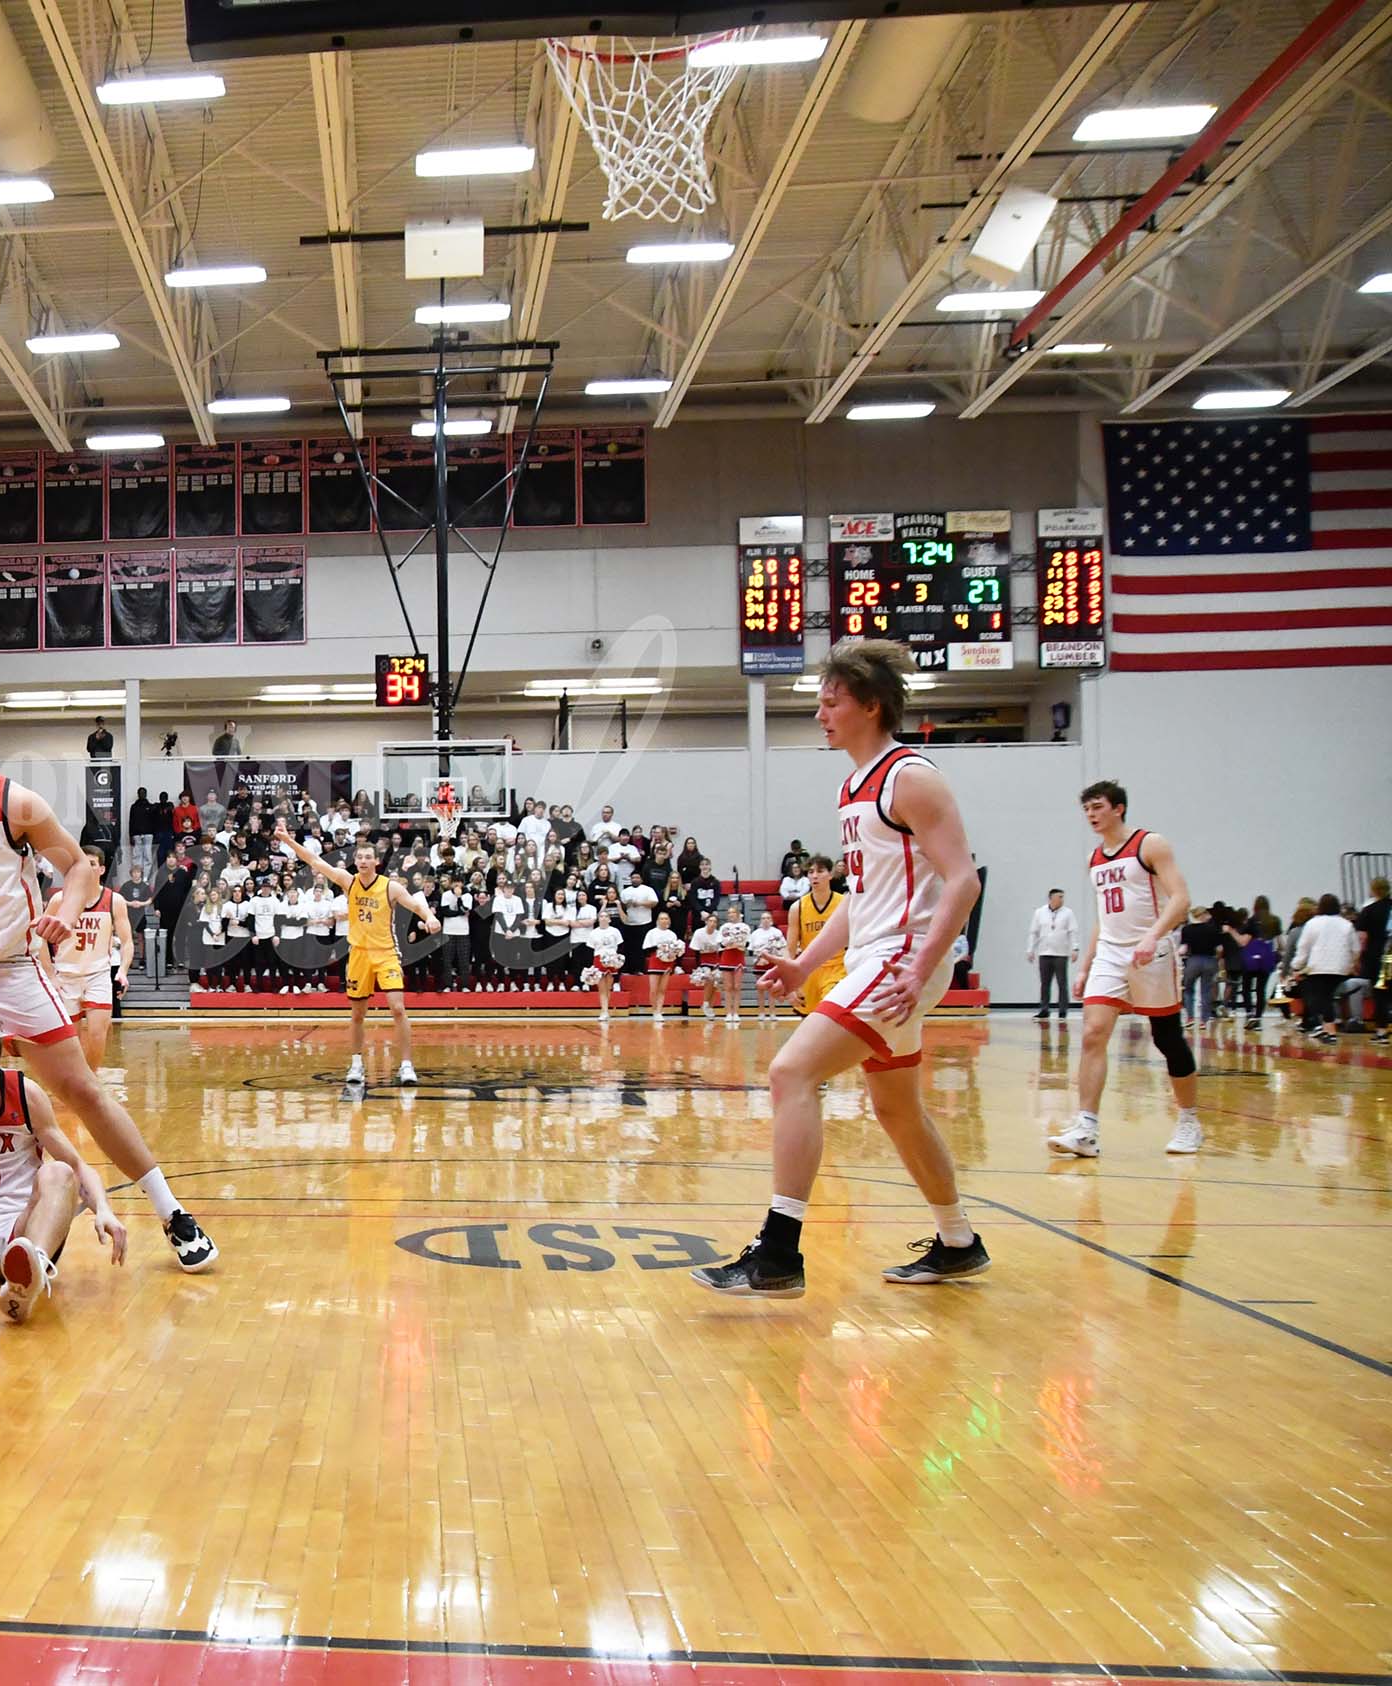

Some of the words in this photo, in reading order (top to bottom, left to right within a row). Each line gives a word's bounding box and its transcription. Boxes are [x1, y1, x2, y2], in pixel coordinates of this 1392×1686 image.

[841, 520, 877, 535] ACE
[896, 514, 944, 528] BRANDON
[901, 526, 939, 538] VALLEY
[902, 541, 953, 566] 7:24
[1051, 551, 1063, 566] 2
[753, 559, 763, 573] 5
[766, 559, 778, 573] 0
[789, 558, 800, 573] 2
[961, 566, 998, 578] GUEST
[1089, 565, 1101, 579] 3
[748, 574, 764, 588] 10
[770, 574, 778, 586] 1
[788, 573, 799, 585] 4
[844, 569, 875, 581] HOME
[906, 574, 933, 582] PERIOD
[849, 582, 880, 605] 22
[915, 583, 928, 603] 3
[968, 579, 999, 604] 27
[1047, 581, 1064, 595] 12
[1066, 580, 1078, 595] 2
[745, 589, 764, 603] 24
[771, 589, 778, 601] 1
[784, 589, 800, 601] 11
[1043, 595, 1064, 610] 23
[1066, 595, 1078, 609] 2
[1088, 594, 1101, 609] 2
[746, 603, 764, 617] 34
[789, 602, 800, 615] 3
[840, 606, 864, 614] FOULS
[896, 605, 924, 614] PLAYER
[926, 604, 945, 613] FOUL
[977, 603, 1003, 611] FOULS
[744, 618, 764, 631] 44
[767, 617, 778, 632] 2
[789, 617, 801, 631] 2
[848, 615, 862, 634] 0
[874, 615, 887, 631] 4
[955, 614, 969, 630] 4
[992, 612, 1001, 629] 1
[1043, 610, 1064, 625] 24
[1088, 609, 1101, 624] 2
[909, 633, 935, 641] MATCH
[979, 632, 1003, 640] SCORE
[961, 645, 1001, 657] Sunshine
[1046, 642, 1100, 651] BRANDON
[909, 647, 946, 668] YNX
[975, 655, 1001, 665] Foods
[1050, 652, 1097, 661] LUMBER
[390, 657, 425, 674] 7:24
[386, 674, 419, 703] 34
[97, 773, 108, 785] G
[238, 774, 297, 784] SANFORD
[1096, 866, 1126, 887] LYNX
[1103, 886, 1125, 914] 10
[358, 909, 372, 923] 24
[75, 932, 97, 952] 34
[394, 1222, 733, 1272] ESD
